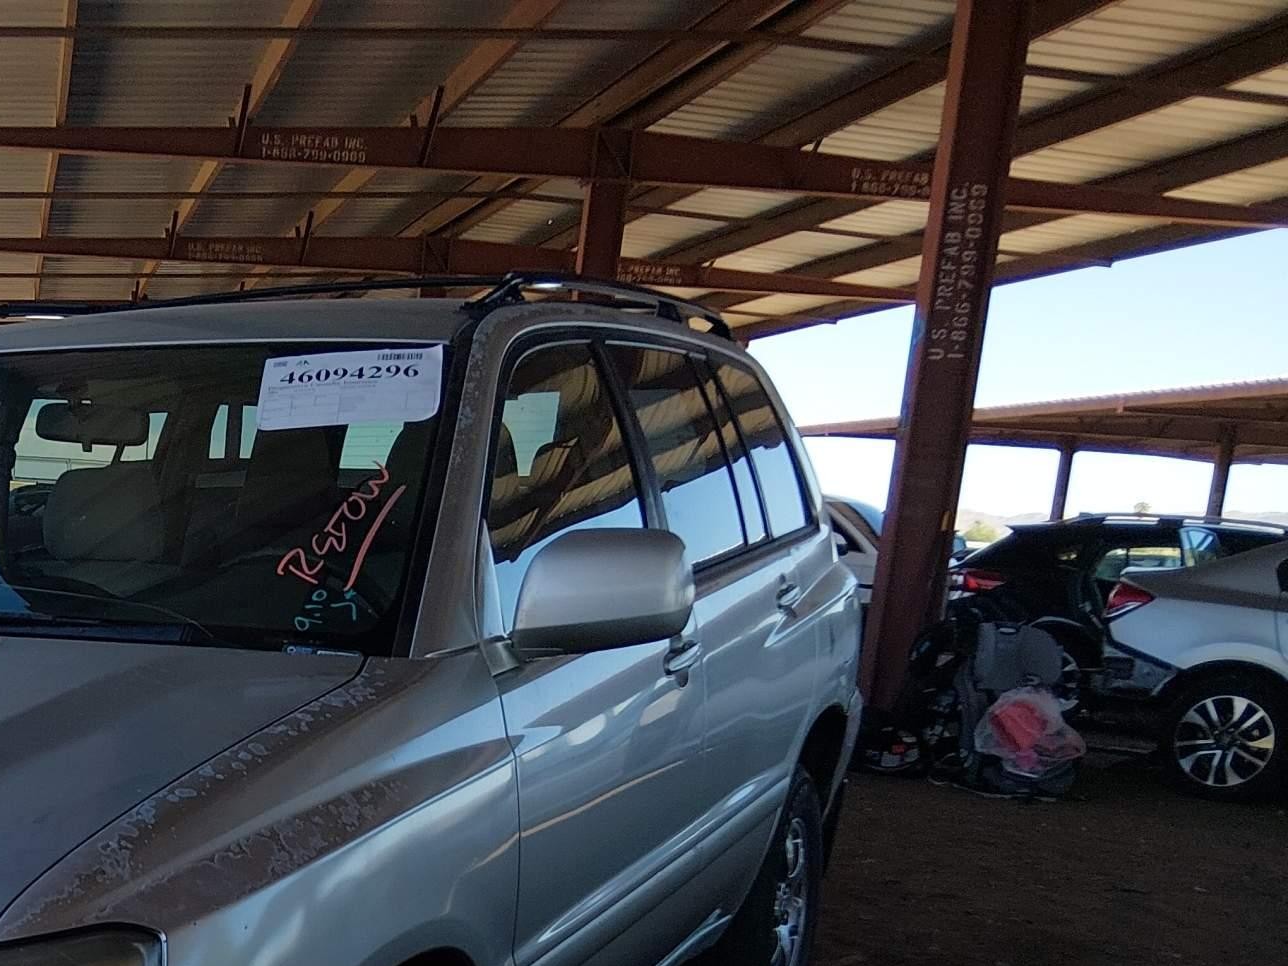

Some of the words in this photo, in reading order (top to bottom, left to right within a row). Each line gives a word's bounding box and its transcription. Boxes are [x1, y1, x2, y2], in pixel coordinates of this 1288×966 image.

[291, 134, 339, 148] PREFAB
[934, 230, 962, 311] PREFAB
[280, 363, 420, 385] 46094296
